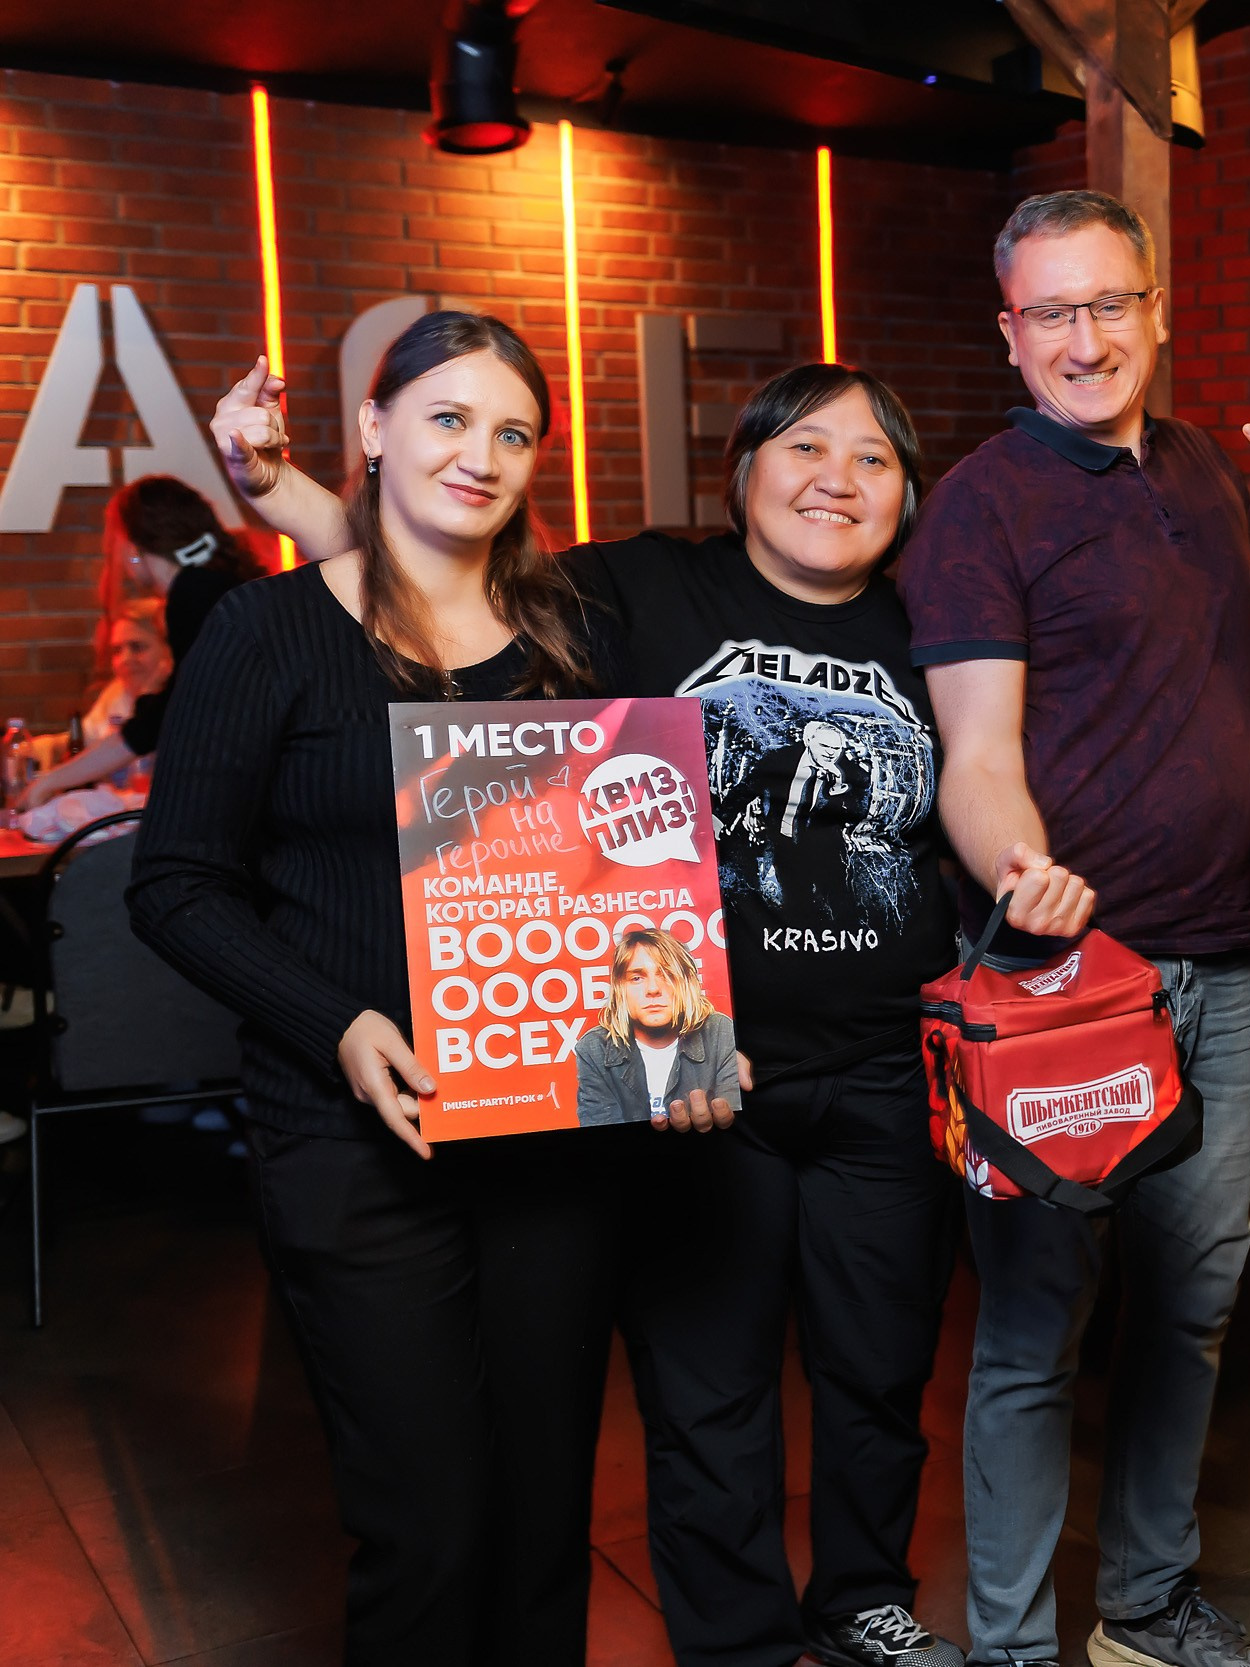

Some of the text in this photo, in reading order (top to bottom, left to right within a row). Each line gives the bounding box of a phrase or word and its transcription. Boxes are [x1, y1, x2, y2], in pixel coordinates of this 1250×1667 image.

[413, 720, 605, 759] 1 МЕСТО
[419, 763, 536, 838] Герой
[580, 765, 691, 820] КВИЗ,
[509, 801, 562, 833] на
[586, 796, 698, 851] ПЛИЗ!
[423, 871, 566, 899] КОМАНДЕ,
[425, 888, 695, 924] КОТОРАЯ РАЗНЕСЛА
[763, 927, 879, 952] KRASIVO
[436, 1017, 587, 1074] ВСЕХ
[443, 1099, 478, 1112] [MUSIC
[479, 1096, 514, 1108] PARTY]
[515, 1094, 535, 1105] РОК
[1019, 1075, 1143, 1128] ШЫМКЕНТСКИЙ
[1036, 1107, 1131, 1133] ПИВОВАРЕННЫЙ ЗАВОД
[1072, 1121, 1097, 1136] 1976
